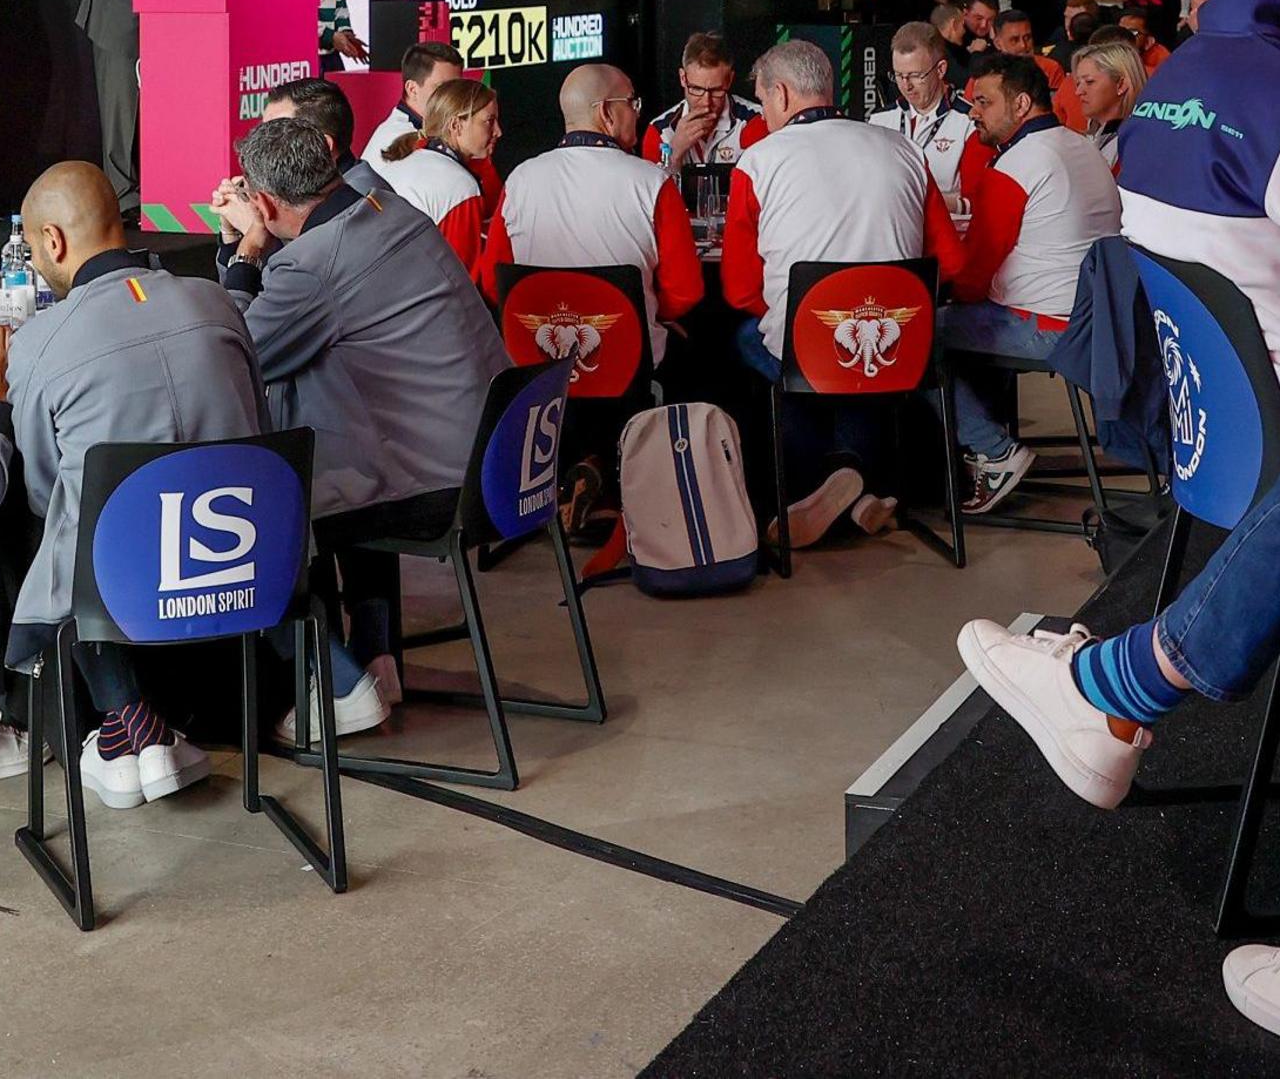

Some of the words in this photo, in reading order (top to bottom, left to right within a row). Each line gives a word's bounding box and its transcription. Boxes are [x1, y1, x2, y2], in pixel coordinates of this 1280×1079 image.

[553, 14, 603, 39] HUNDRED
[553, 35, 603, 62] AUCTION
[240, 60, 310, 91] HUNDRED
[864, 46, 876, 123] NDRED
[519, 397, 562, 493] LS
[158, 486, 257, 592] LS
[158, 593, 217, 620] LONDON
[218, 587, 255, 613] SPIRIT
